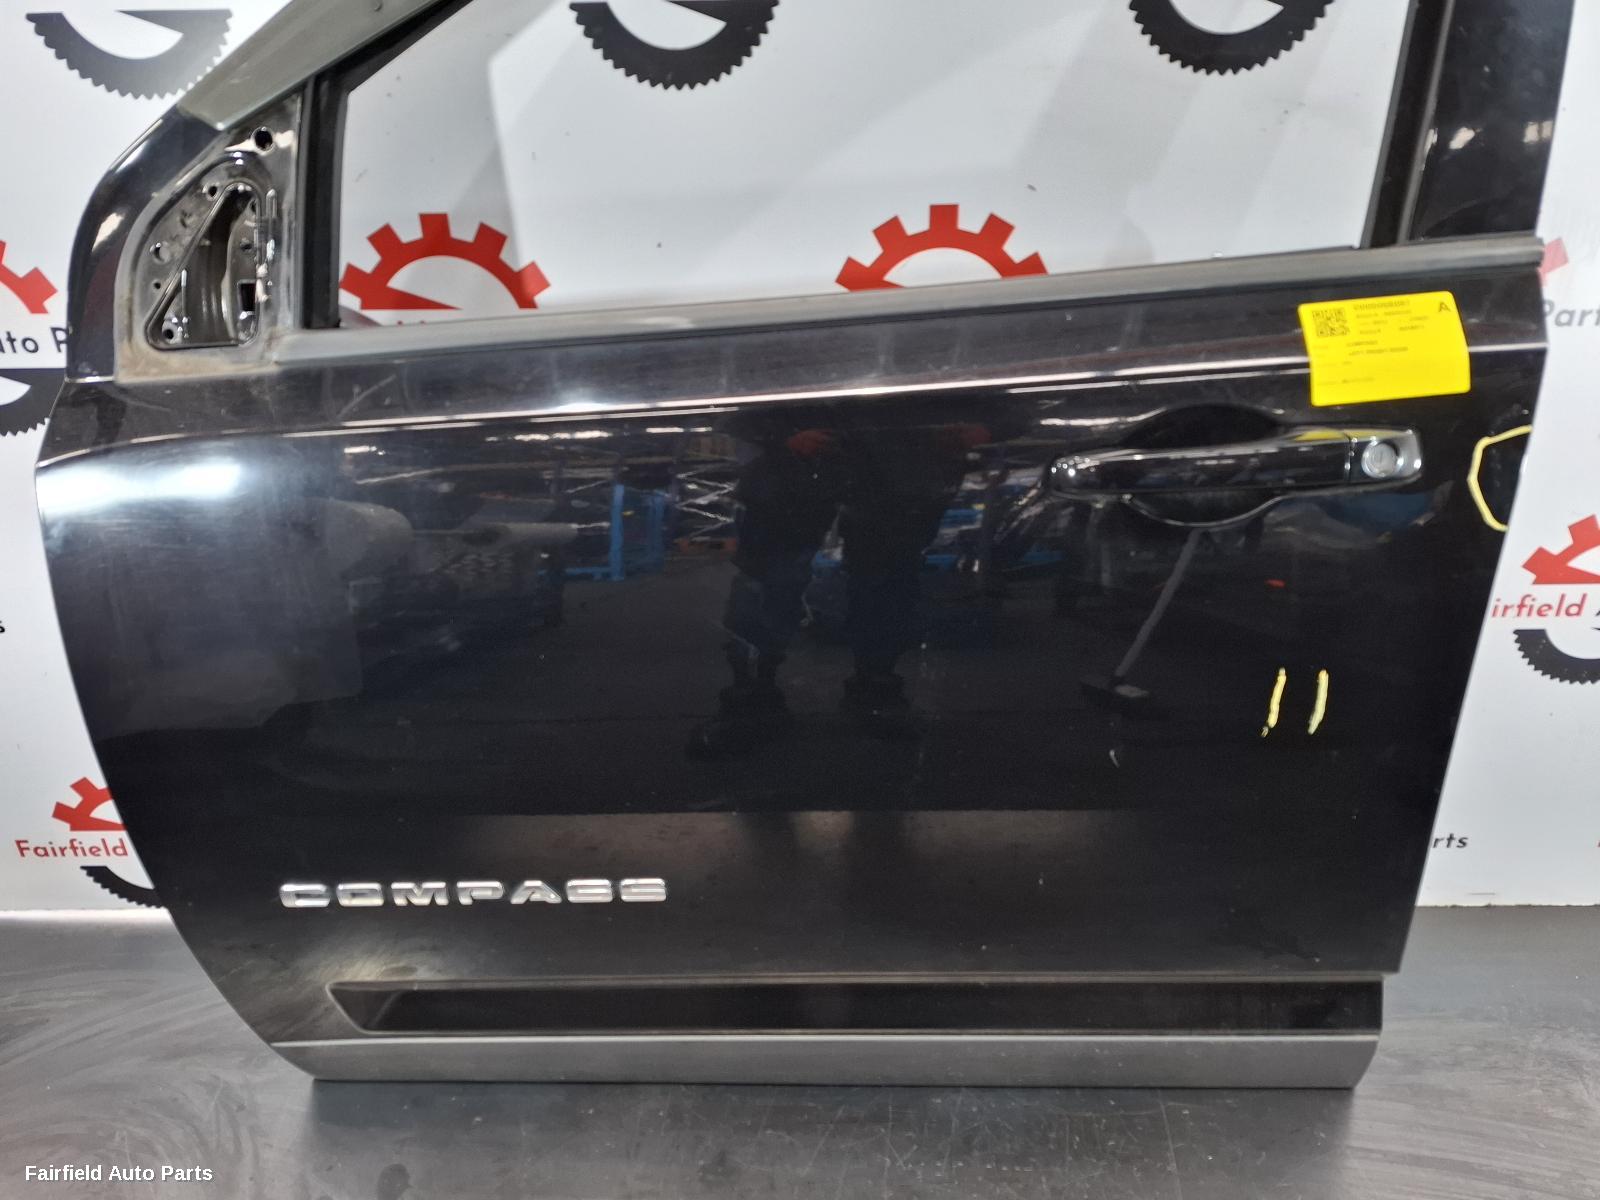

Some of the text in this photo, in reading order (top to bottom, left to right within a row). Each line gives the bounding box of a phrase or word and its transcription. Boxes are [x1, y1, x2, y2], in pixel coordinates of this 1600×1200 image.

[1438, 301, 1451, 313] A
[15, 838, 129, 857] Fairfield
[279, 878, 667, 908] COMPASS
